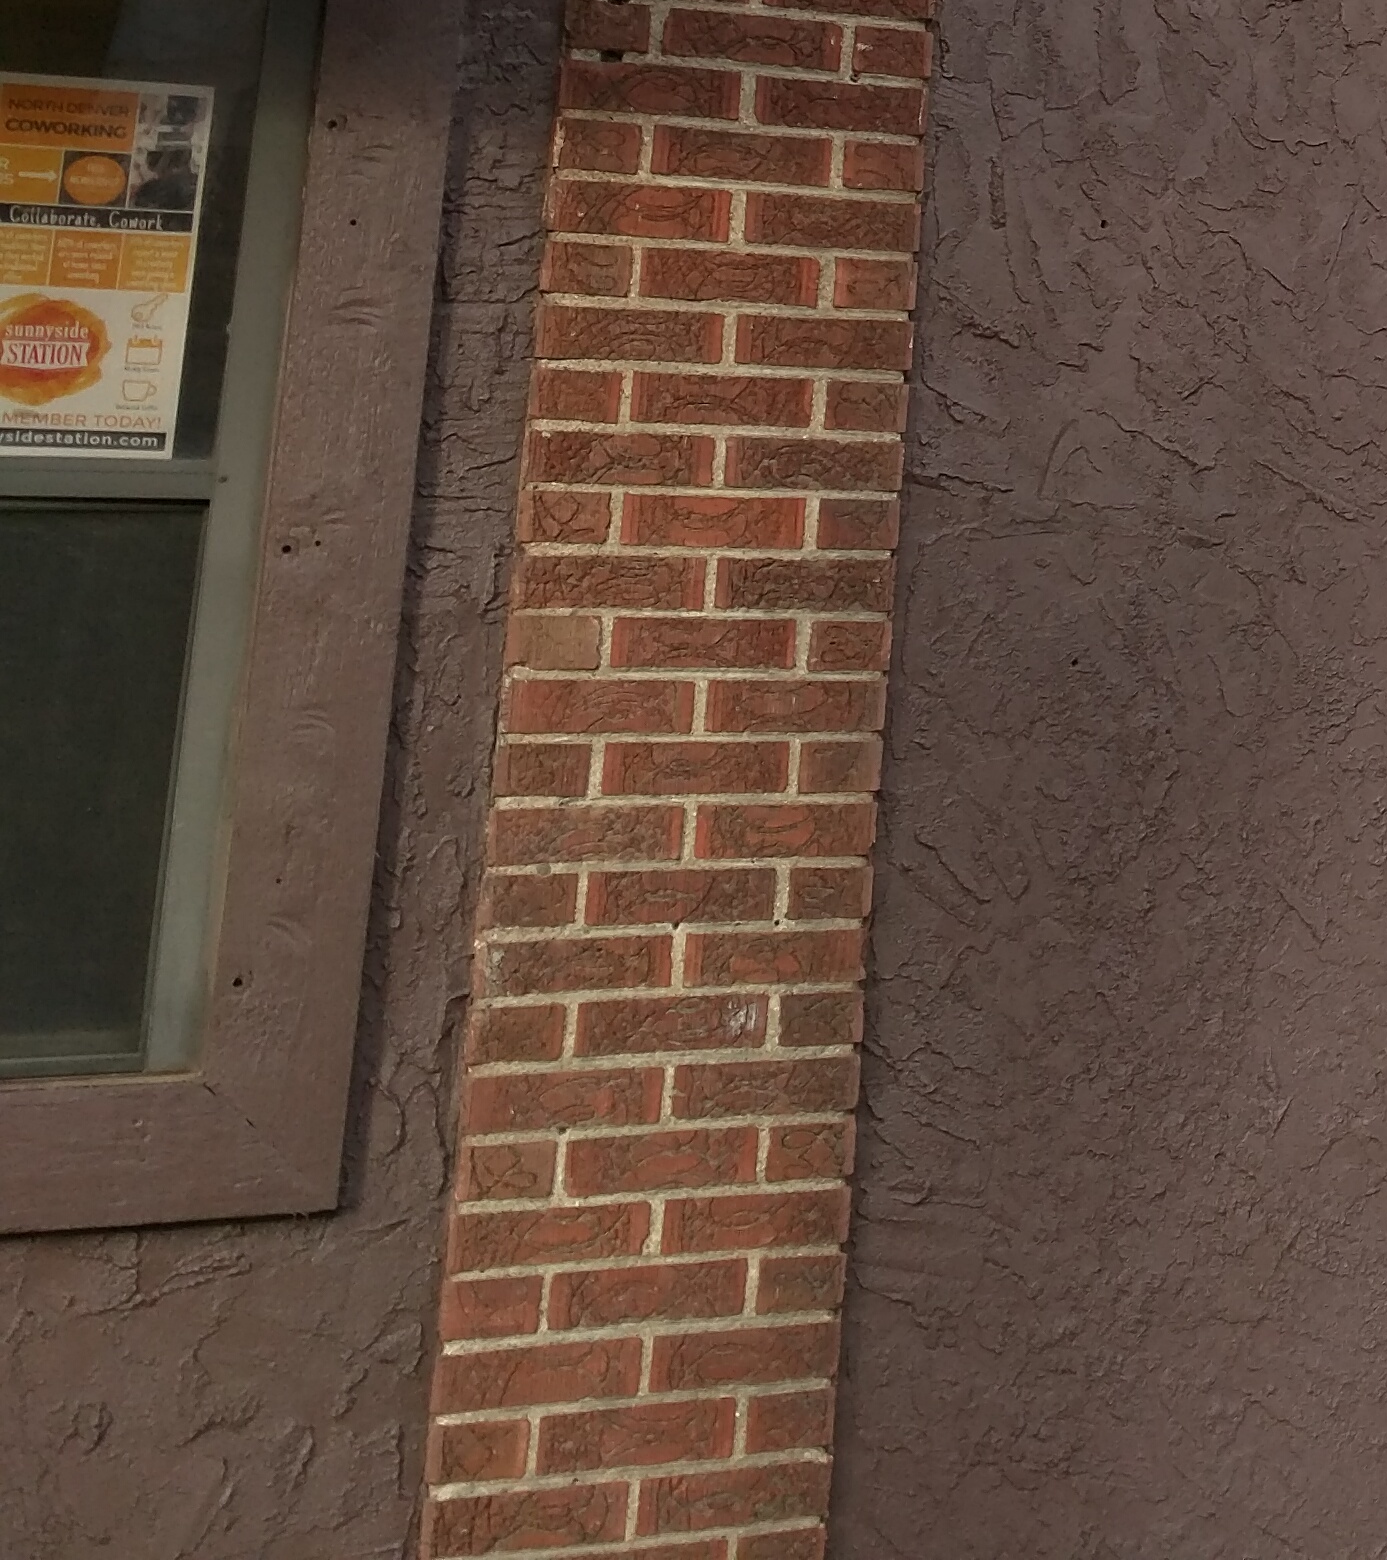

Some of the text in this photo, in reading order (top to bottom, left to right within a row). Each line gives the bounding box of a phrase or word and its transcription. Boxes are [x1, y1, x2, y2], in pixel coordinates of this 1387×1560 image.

[8, 98, 130, 118] NORTH DENVER
[5, 117, 127, 139] COWORKING
[9, 204, 164, 231] Collaborate. Cowork
[5, 320, 90, 341] sunnyside
[6, 343, 85, 366] STATION
[2, 411, 162, 429] MEMBER TODAY!
